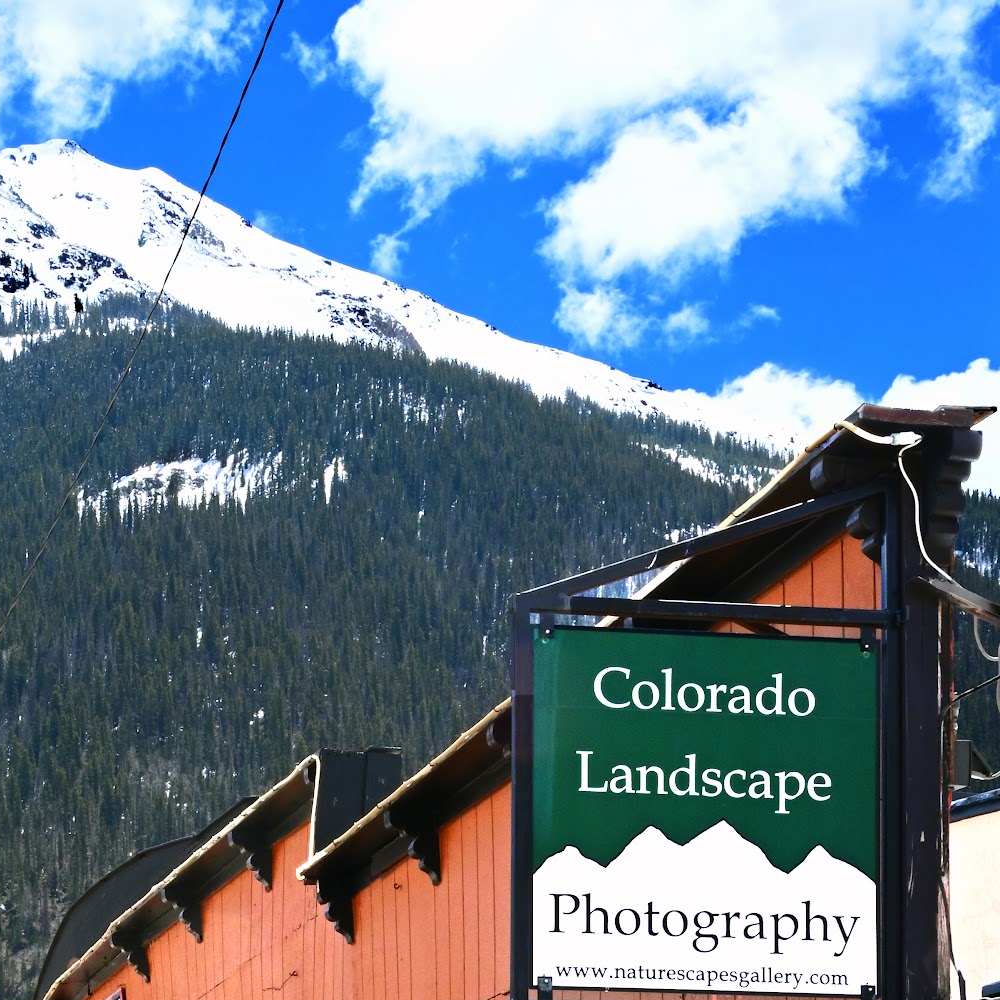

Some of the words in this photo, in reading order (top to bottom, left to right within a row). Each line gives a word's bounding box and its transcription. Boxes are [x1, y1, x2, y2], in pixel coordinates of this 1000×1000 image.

[593, 666, 816, 717] Colorado
[575, 750, 832, 814] Landscape
[548, 892, 861, 957] Photography
[555, 963, 849, 989] www.naturescapesgallery.com
